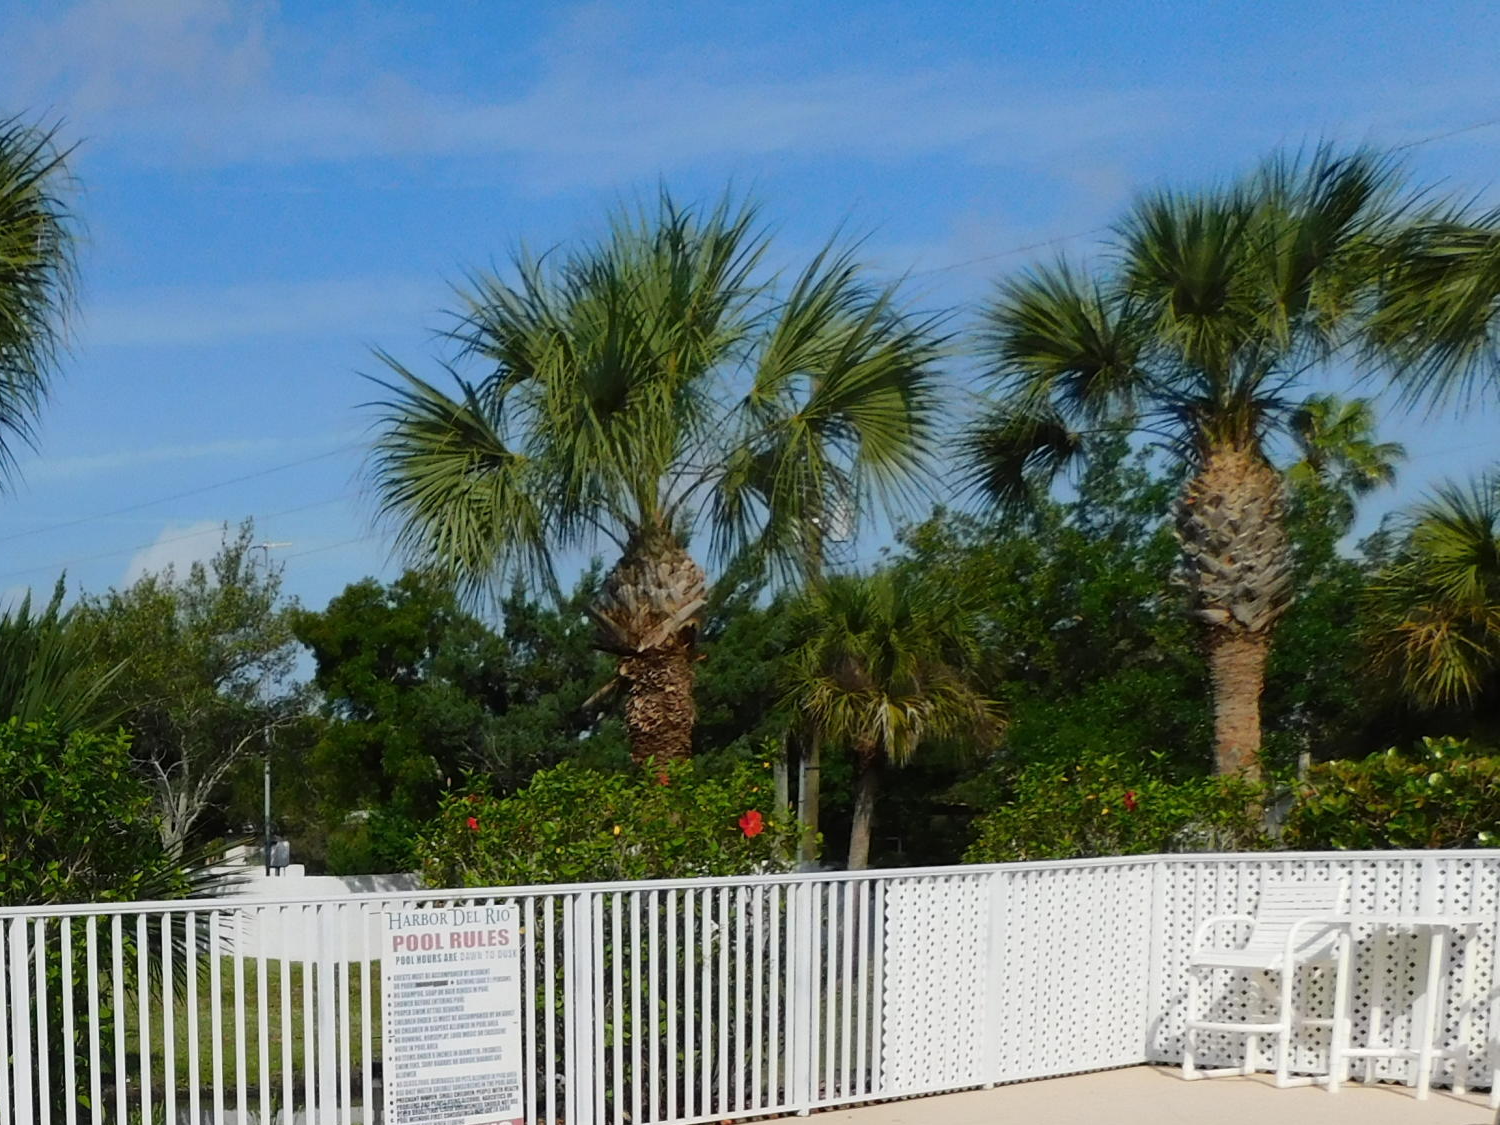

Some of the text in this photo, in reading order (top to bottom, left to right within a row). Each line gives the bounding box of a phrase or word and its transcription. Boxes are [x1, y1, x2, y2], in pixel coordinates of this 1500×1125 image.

[392, 929, 509, 952] POOL RULES
[396, 954, 414, 965] POOL
[416, 954, 441, 964] HOURS
[444, 952, 458, 961] ARE
[486, 950, 494, 958] TO
